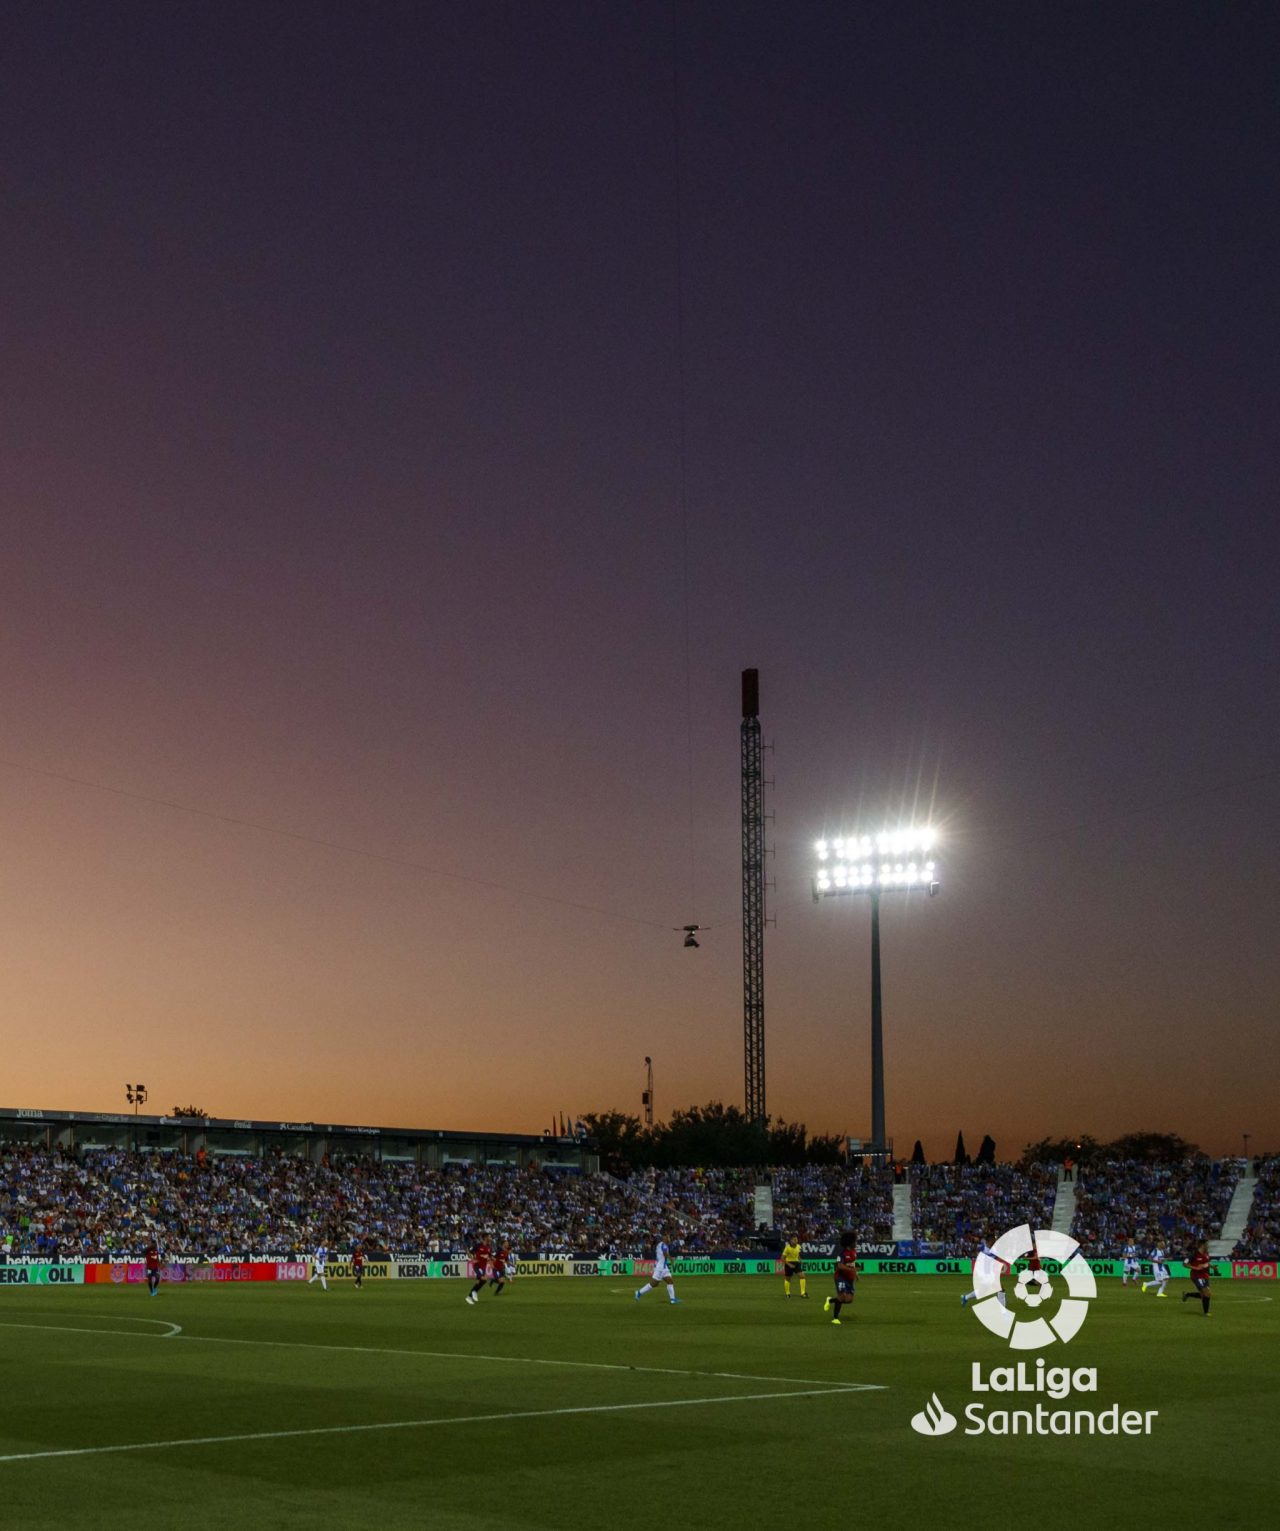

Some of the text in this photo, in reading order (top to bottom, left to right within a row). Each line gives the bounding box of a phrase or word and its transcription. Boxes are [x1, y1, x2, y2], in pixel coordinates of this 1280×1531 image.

[801, 1242, 836, 1256] tway
[855, 1242, 896, 1256] etway
[6, 1255, 53, 1265] betway
[59, 1255, 104, 1265] betway
[109, 1254, 147, 1265] betwa
[250, 1254, 289, 1264] betway
[277, 1265, 306, 1279] H40
[668, 1262, 716, 1274] EVOLUTION
[1235, 1264, 1274, 1278] H40
